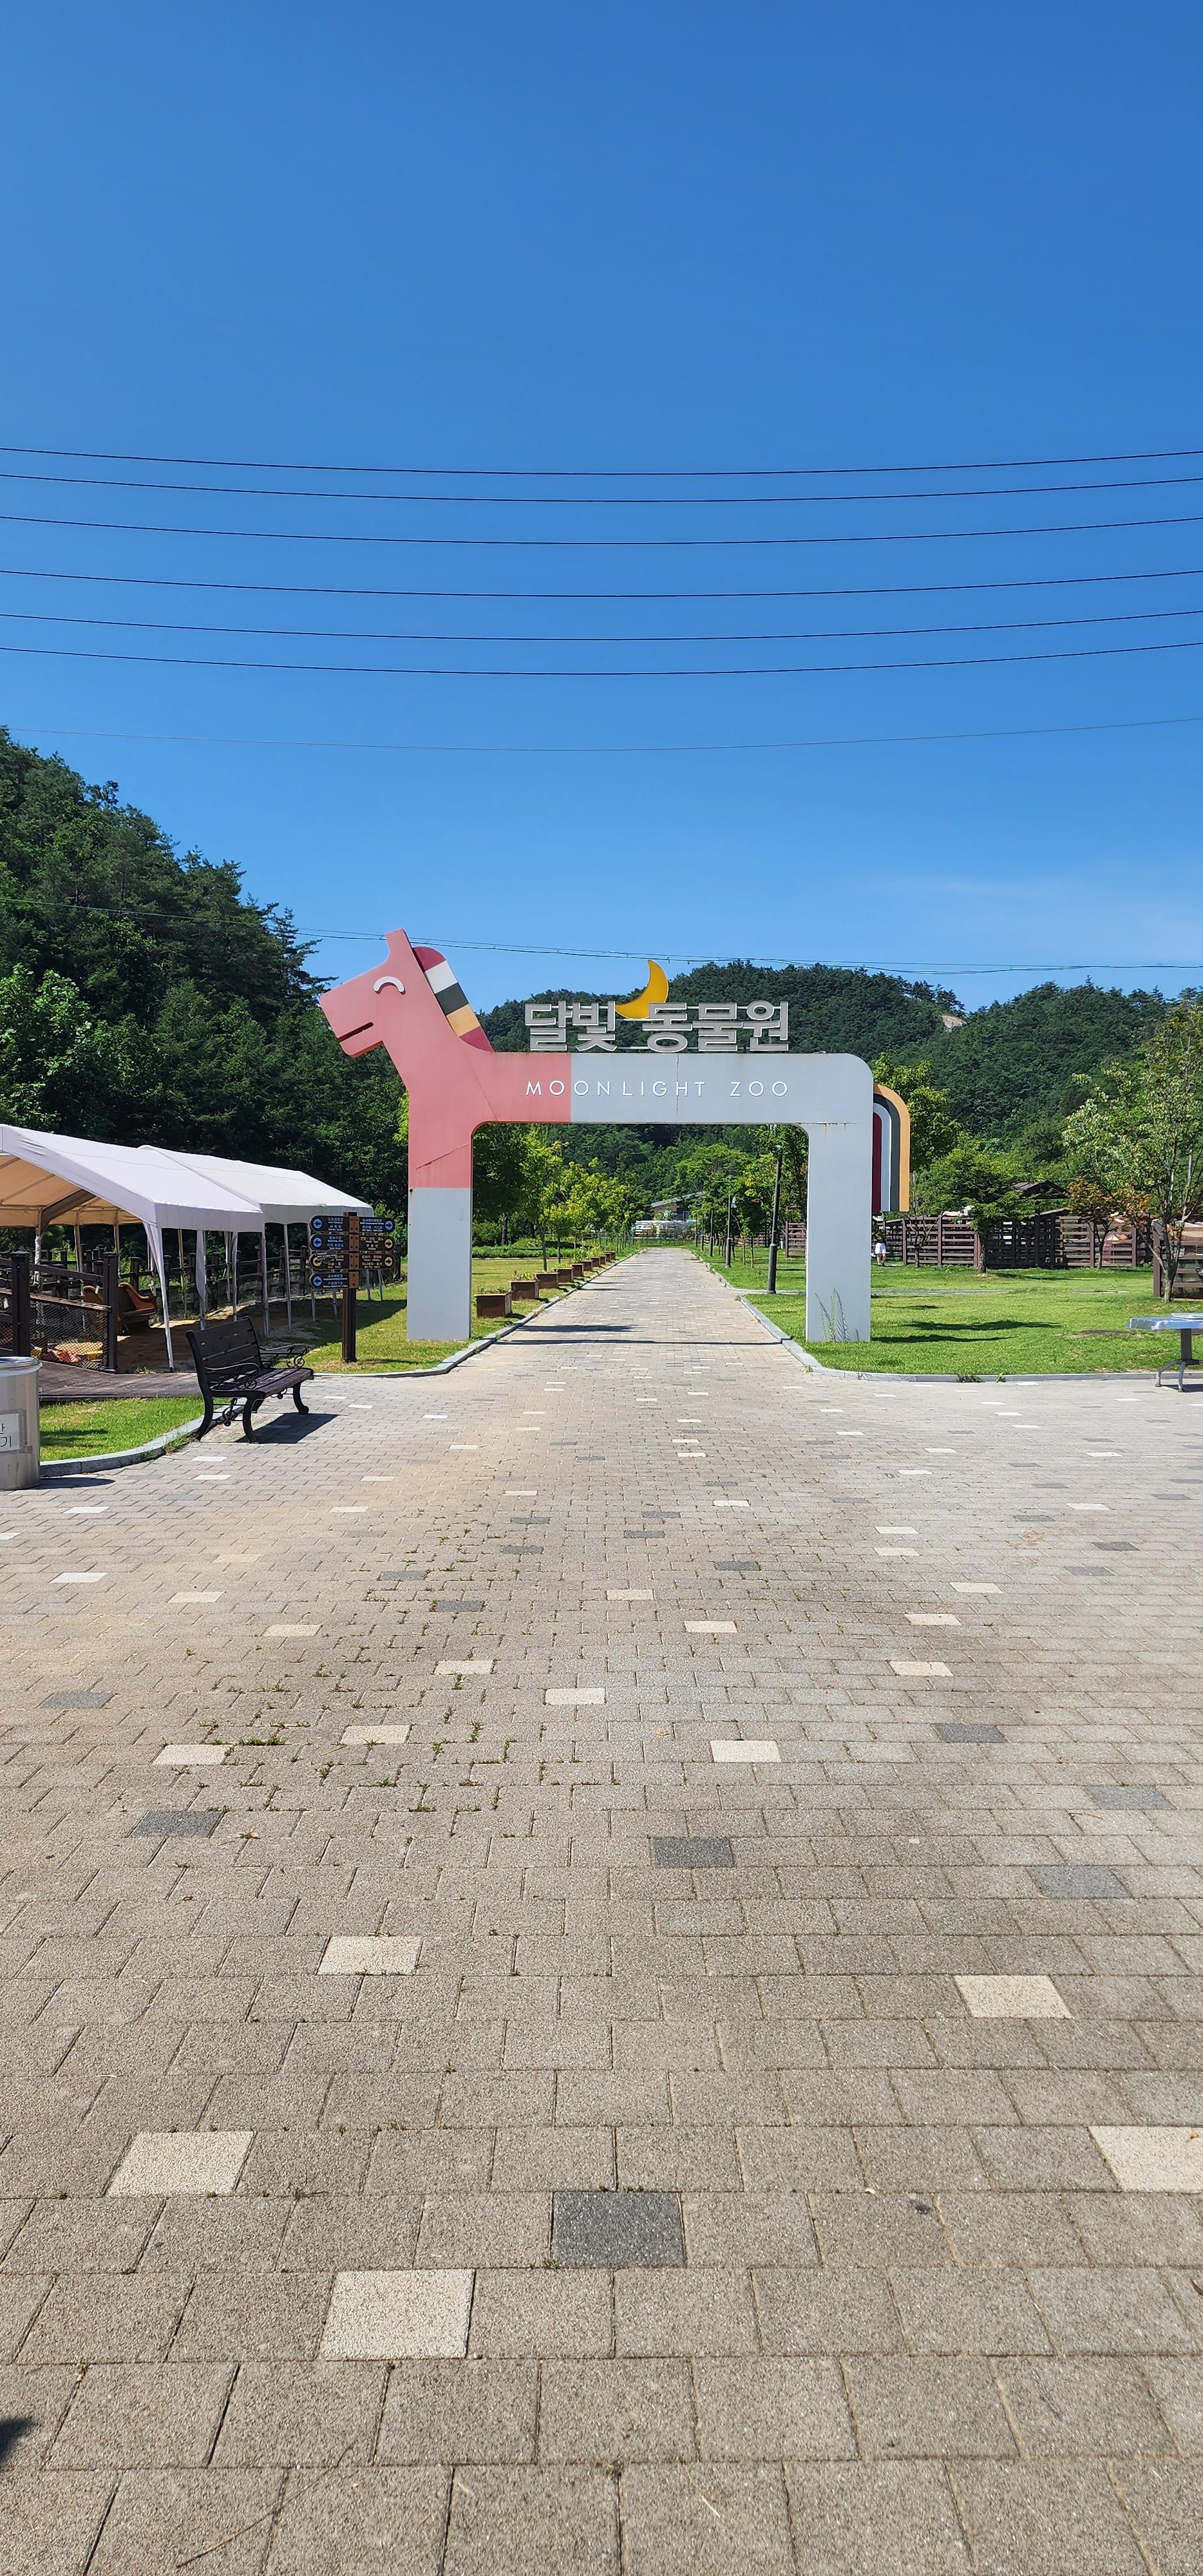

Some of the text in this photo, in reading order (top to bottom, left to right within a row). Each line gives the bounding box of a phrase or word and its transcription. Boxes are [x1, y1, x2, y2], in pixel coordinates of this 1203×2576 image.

[524, 1000, 789, 1053] 달빛 동물원
[526, 1080, 788, 1097] MOONLIGHT ZOO
